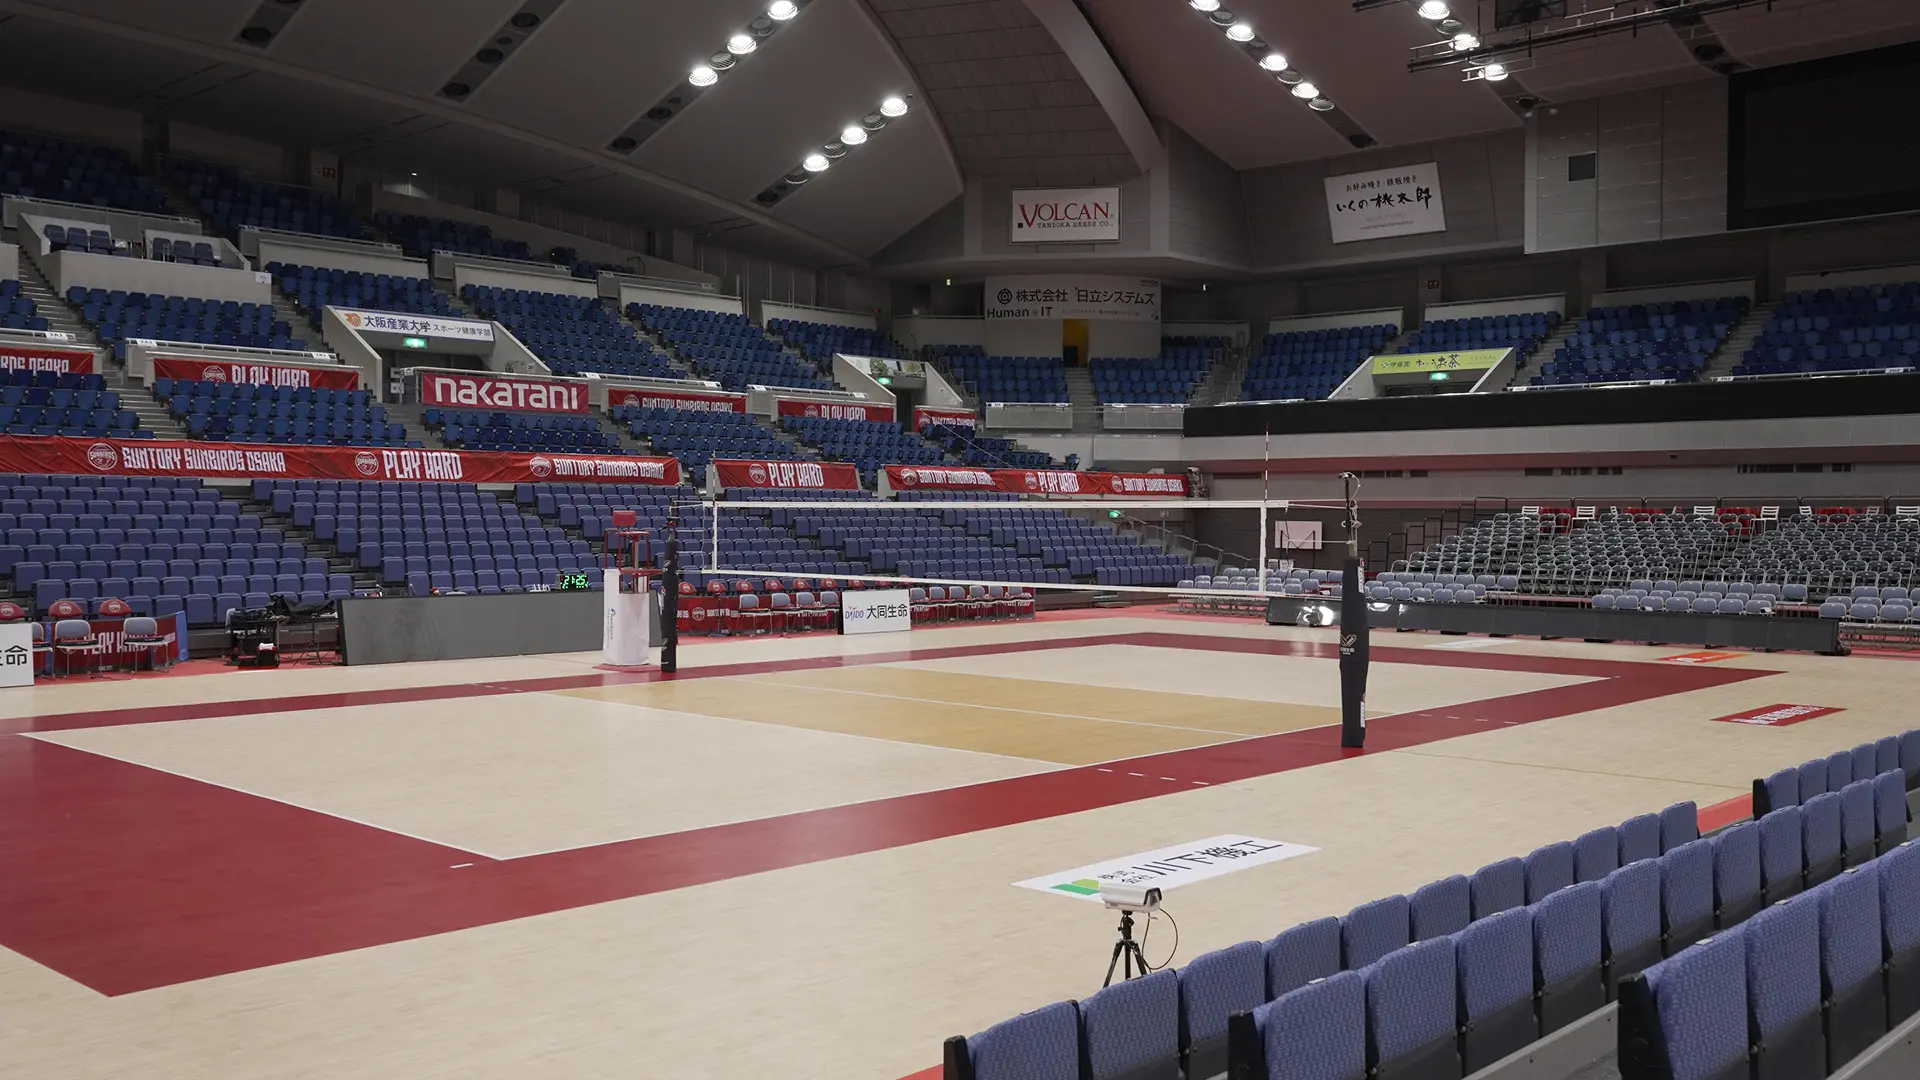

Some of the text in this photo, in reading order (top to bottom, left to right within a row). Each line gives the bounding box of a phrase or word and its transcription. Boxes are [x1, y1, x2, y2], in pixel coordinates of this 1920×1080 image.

[1336, 186, 1433, 212] いくの桃太郎
[1019, 202, 1110, 228] VOLCAN
[1015, 289, 1156, 305] 株式会社 日立システムズ
[987, 307, 1029, 318] Human
[1041, 306, 1053, 317] IT
[363, 315, 491, 336] 大阪産業大学 スポーツ健康学部
[121, 447, 286, 472] SUNTORY SUNBIRDS OSAKA
[382, 450, 463, 480] PLAY HARD
[553, 458, 595, 476] SUNTORY
[595, 459, 638, 477] SUNBIRDS
[767, 463, 824, 487] PLAY HARD
[1037, 471, 1080, 492] PLAY HARD
[867, 603, 908, 619] 大同生命
[1131, 840, 1283, 877] 川下機工
